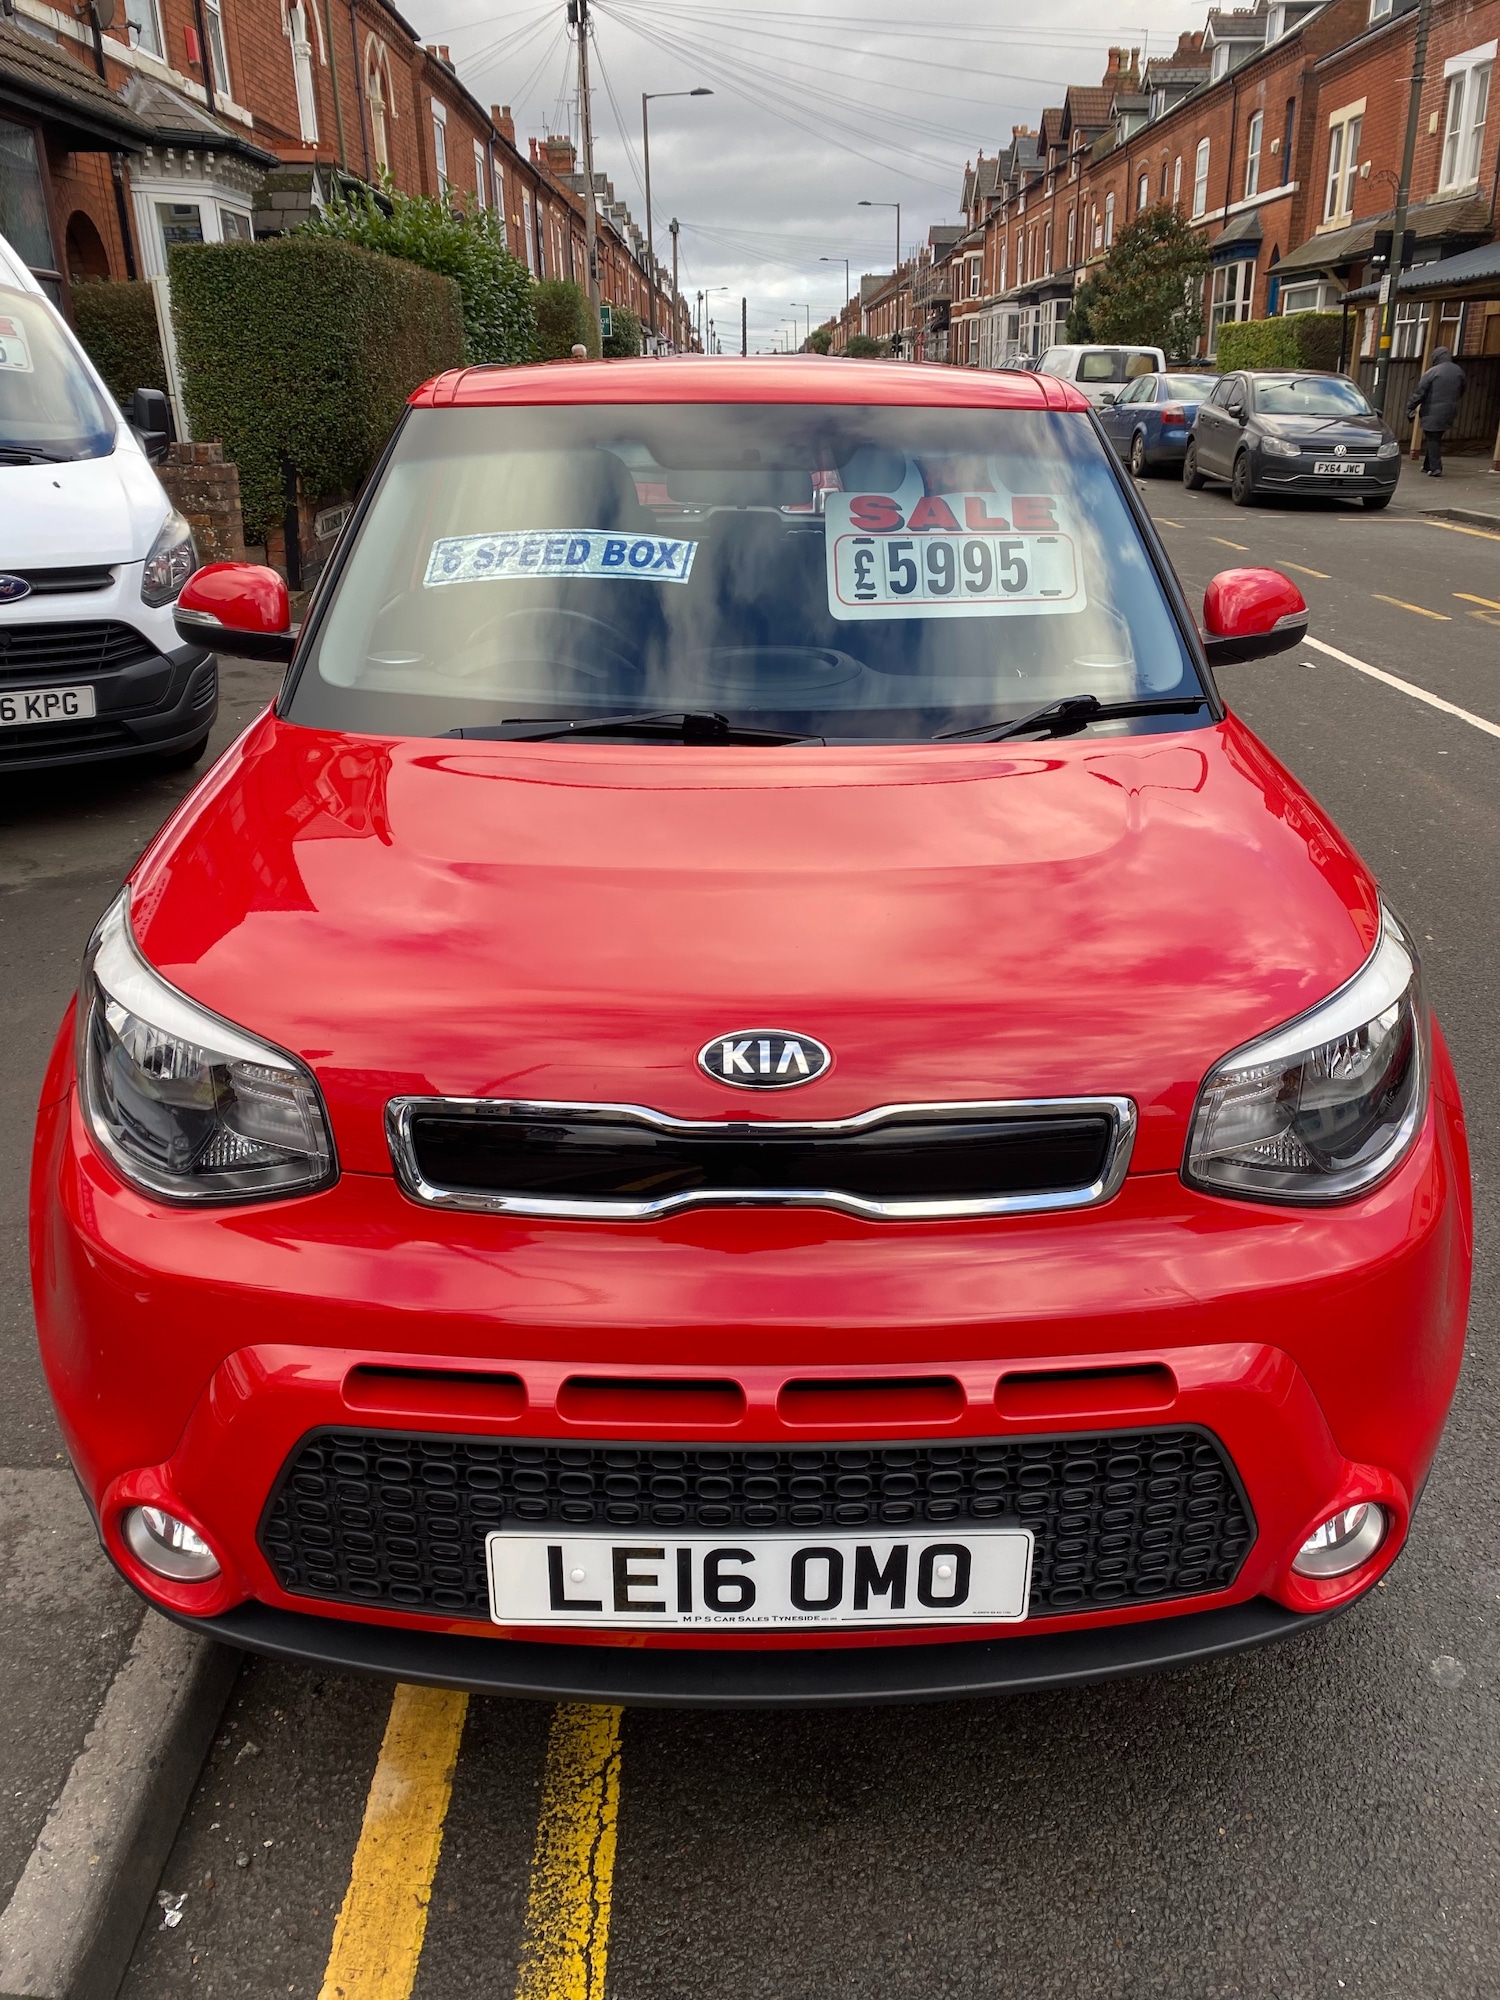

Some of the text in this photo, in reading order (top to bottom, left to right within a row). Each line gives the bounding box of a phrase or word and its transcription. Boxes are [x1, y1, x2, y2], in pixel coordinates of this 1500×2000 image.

[1317, 463, 1361, 474] FX64 JWC
[849, 495, 1060, 533] SALE
[473, 539, 591, 570] SPEED
[601, 539, 682, 570] BOX
[854, 540, 1029, 596] £5995
[24, 692, 79, 720] KPG
[721, 1040, 811, 1075] KIA
[547, 1543, 973, 1613] LE16 OMO
